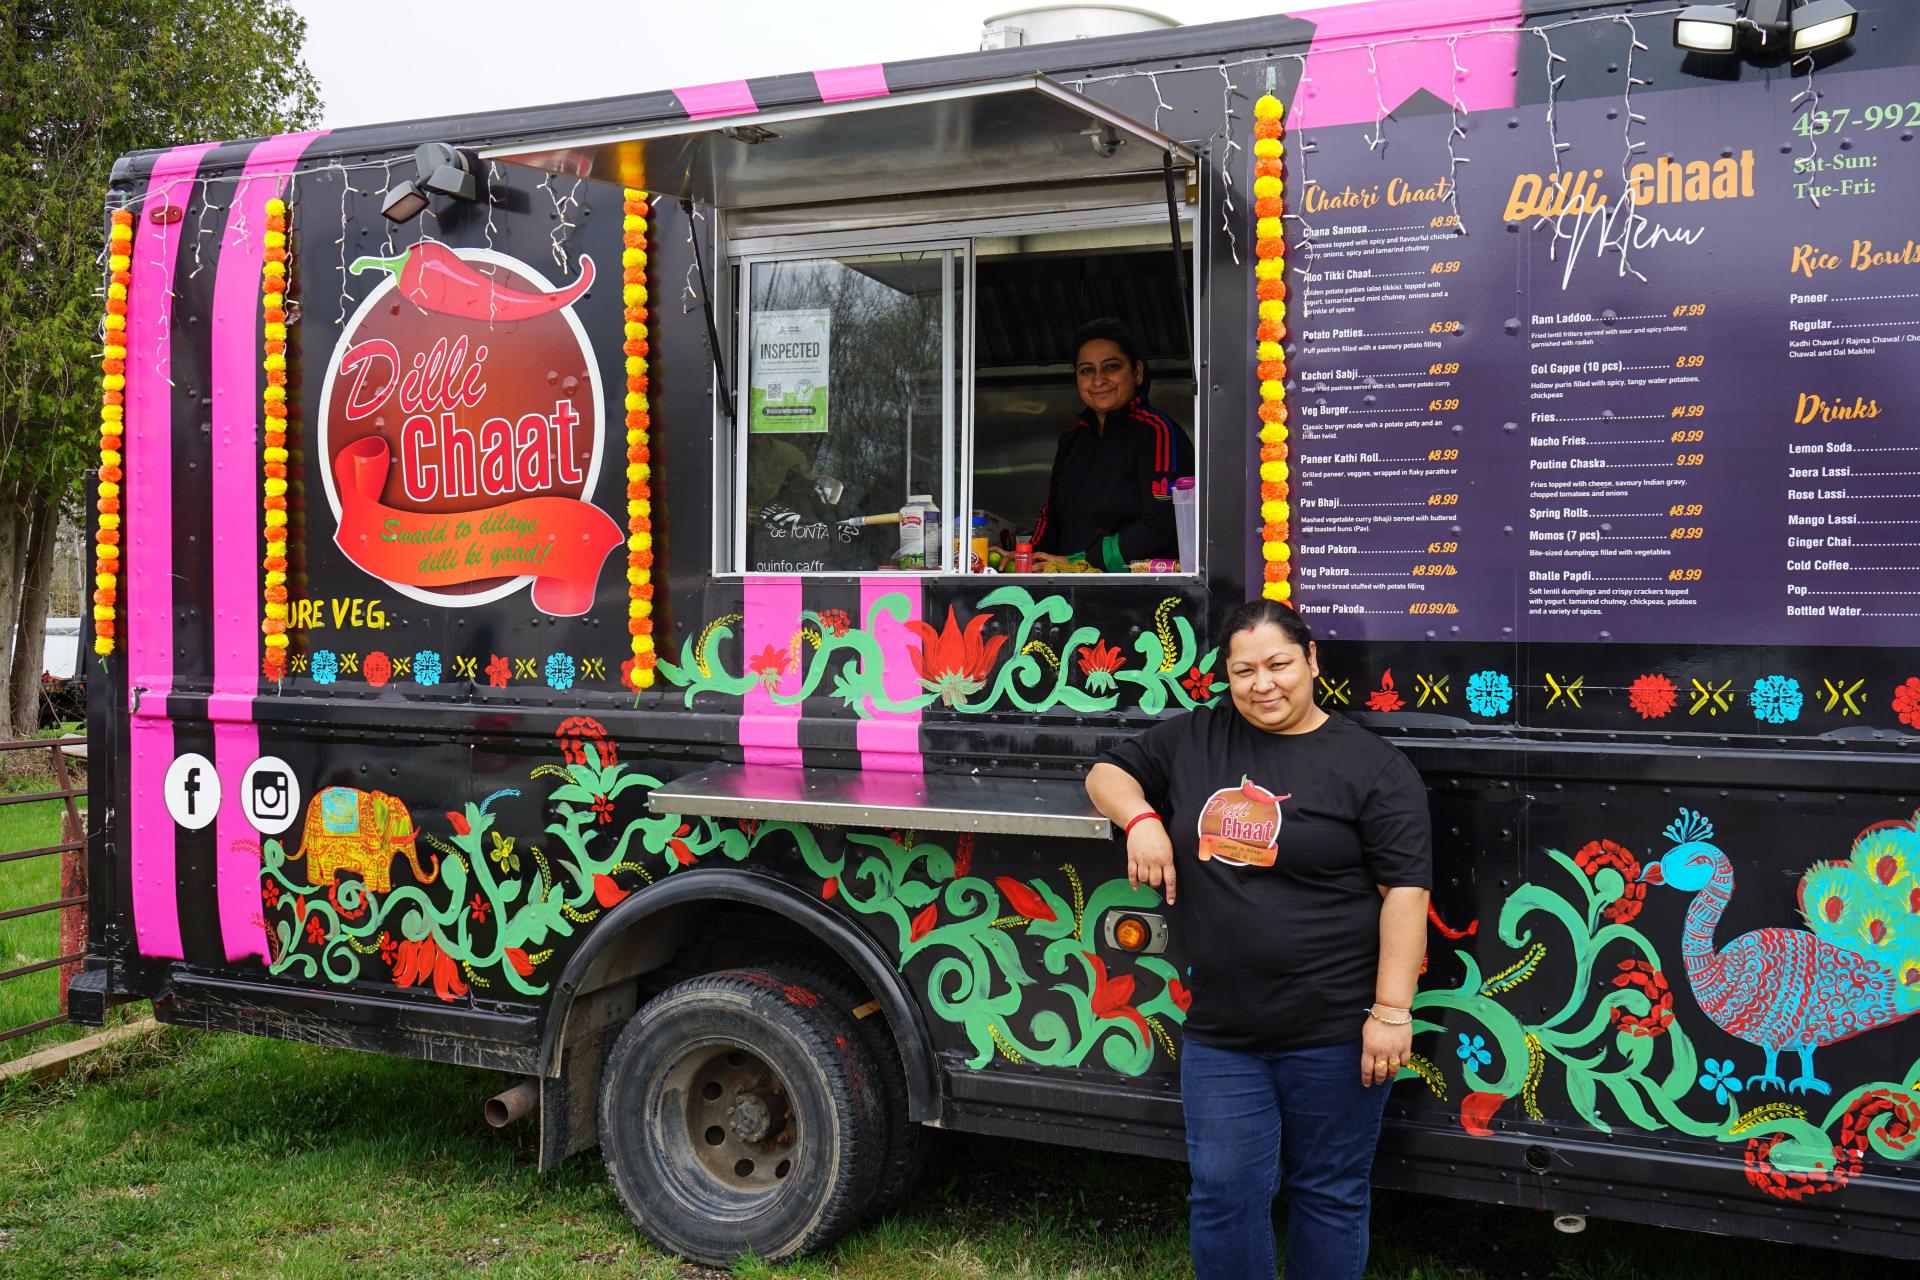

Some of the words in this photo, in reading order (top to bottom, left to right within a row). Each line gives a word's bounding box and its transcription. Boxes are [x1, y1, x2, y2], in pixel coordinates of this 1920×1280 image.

[1794, 154, 1877, 174] Sat-Sun:
[1503, 169, 1607, 221] Dilli
[1629, 149, 1755, 206] chaat
[1793, 178, 1875, 199] Tue-Fri:
[1305, 184, 1379, 213] Chatori
[1387, 176, 1449, 206] Chaat
[1303, 228, 1330, 237] Chana
[1333, 225, 1367, 235] Samosa
[1430, 215, 1460, 228] $8.99
[1557, 187, 1704, 291] Menu
[1791, 244, 1842, 278] Rice
[1303, 273, 1321, 282] Aloo
[1324, 271, 1344, 280] Tikki
[1347, 269, 1371, 279] Chaat
[1430, 261, 1461, 274] $6.99
[1790, 294, 1828, 304] Paneer
[1532, 315, 1553, 325] Ram
[1557, 313, 1592, 323] Laddoo
[1673, 304, 1706, 317] $7.99
[1303, 331, 1329, 340] Potato
[1333, 329, 1363, 338] Patties
[1429, 321, 1460, 334] $5.99
[1790, 320, 1832, 332] Regular
[761, 342, 820, 359] INSPECTED
[1848, 347, 1875, 355] Makhni
[1302, 371, 1334, 381] Kachori
[1336, 369, 1357, 380] Sabji
[1429, 362, 1459, 375] $8.99
[1531, 365, 1548, 374] Gol
[1550, 363, 1580, 374] Gappe
[1584, 362, 1598, 373] (10
[1602, 361, 1622, 373] pcs)
[1676, 355, 1704, 368] 8.99
[340, 335, 489, 421] Dilli
[1302, 406, 1317, 416] Veg
[1320, 406, 1349, 416] Burger
[1429, 399, 1459, 411] $5.99
[1531, 413, 1555, 422] Fries
[1672, 405, 1704, 418] $4.99
[1794, 392, 1882, 424] Drinks
[1530, 437, 1559, 446] Nacho
[1563, 436, 1586, 445] Fries
[1671, 430, 1703, 443] $9.99
[401, 400, 582, 501] Chaat
[1789, 444, 1823, 454] Lemon
[1826, 442, 1852, 452] Soda
[1301, 455, 1331, 464] Paneer
[1335, 454, 1357, 463] Kathi
[1360, 453, 1379, 462] Roll
[1428, 449, 1458, 461] $8.99
[1530, 460, 1567, 469] Poutine
[1570, 459, 1605, 468] Chaska
[1676, 454, 1704, 466] 9.99
[1789, 468, 1818, 478] Jeera
[1822, 466, 1850, 477] Lassi
[1301, 499, 1315, 507] Pav
[1318, 498, 1340, 507] Bhaji
[1428, 494, 1458, 505] $8.99
[1788, 490, 1814, 499] Rose
[1818, 489, 1846, 499] Lassi
[1530, 509, 1560, 520] Spring
[1564, 508, 1588, 517] Rolls
[1669, 504, 1702, 516] $8.99
[1788, 515, 1824, 526] Mango
[1828, 514, 1857, 524] Lassi
[380, 519, 450, 545] Swadd
[455, 520, 472, 541] to
[479, 509, 538, 538] dilaye
[1530, 531, 1564, 540] Momos
[1567, 531, 1576, 542] (7
[1580, 530, 1600, 542] pcs)
[1670, 527, 1703, 539] $9.99
[1301, 545, 1325, 553] Bread
[1328, 545, 1357, 553] Pakora
[1427, 542, 1457, 553] $5.99
[1788, 537, 1824, 549] Ginger
[1827, 537, 1852, 546] Chai
[419, 553, 459, 573] dilli
[465, 542, 483, 566] ki
[490, 544, 552, 571] yaad!
[1787, 560, 1811, 570] Cold
[1814, 560, 1849, 570] Coffee
[1301, 567, 1316, 577] Veg
[1320, 567, 1349, 575] Pakora
[1412, 565, 1457, 576] $8.99/lb
[1529, 571, 1560, 580] Bhalle
[1563, 571, 1591, 582] Papdi
[1668, 569, 1702, 581] $8.99
[1562, 588, 1596, 596] dumplings
[1665, 588, 1688, 596] topped
[1787, 585, 1807, 596] Pop
[285, 599, 325, 629] URE
[331, 597, 392, 631] VEG.
[1300, 605, 1330, 613] Paneer
[1333, 604, 1364, 613] Pakoda
[1409, 603, 1459, 615] $10.99/lb
[1549, 608, 1570, 616] variety
[1787, 606, 1825, 616] Bottled
[1829, 606, 1861, 615] Water
[1221, 817, 1273, 841] Chaat
